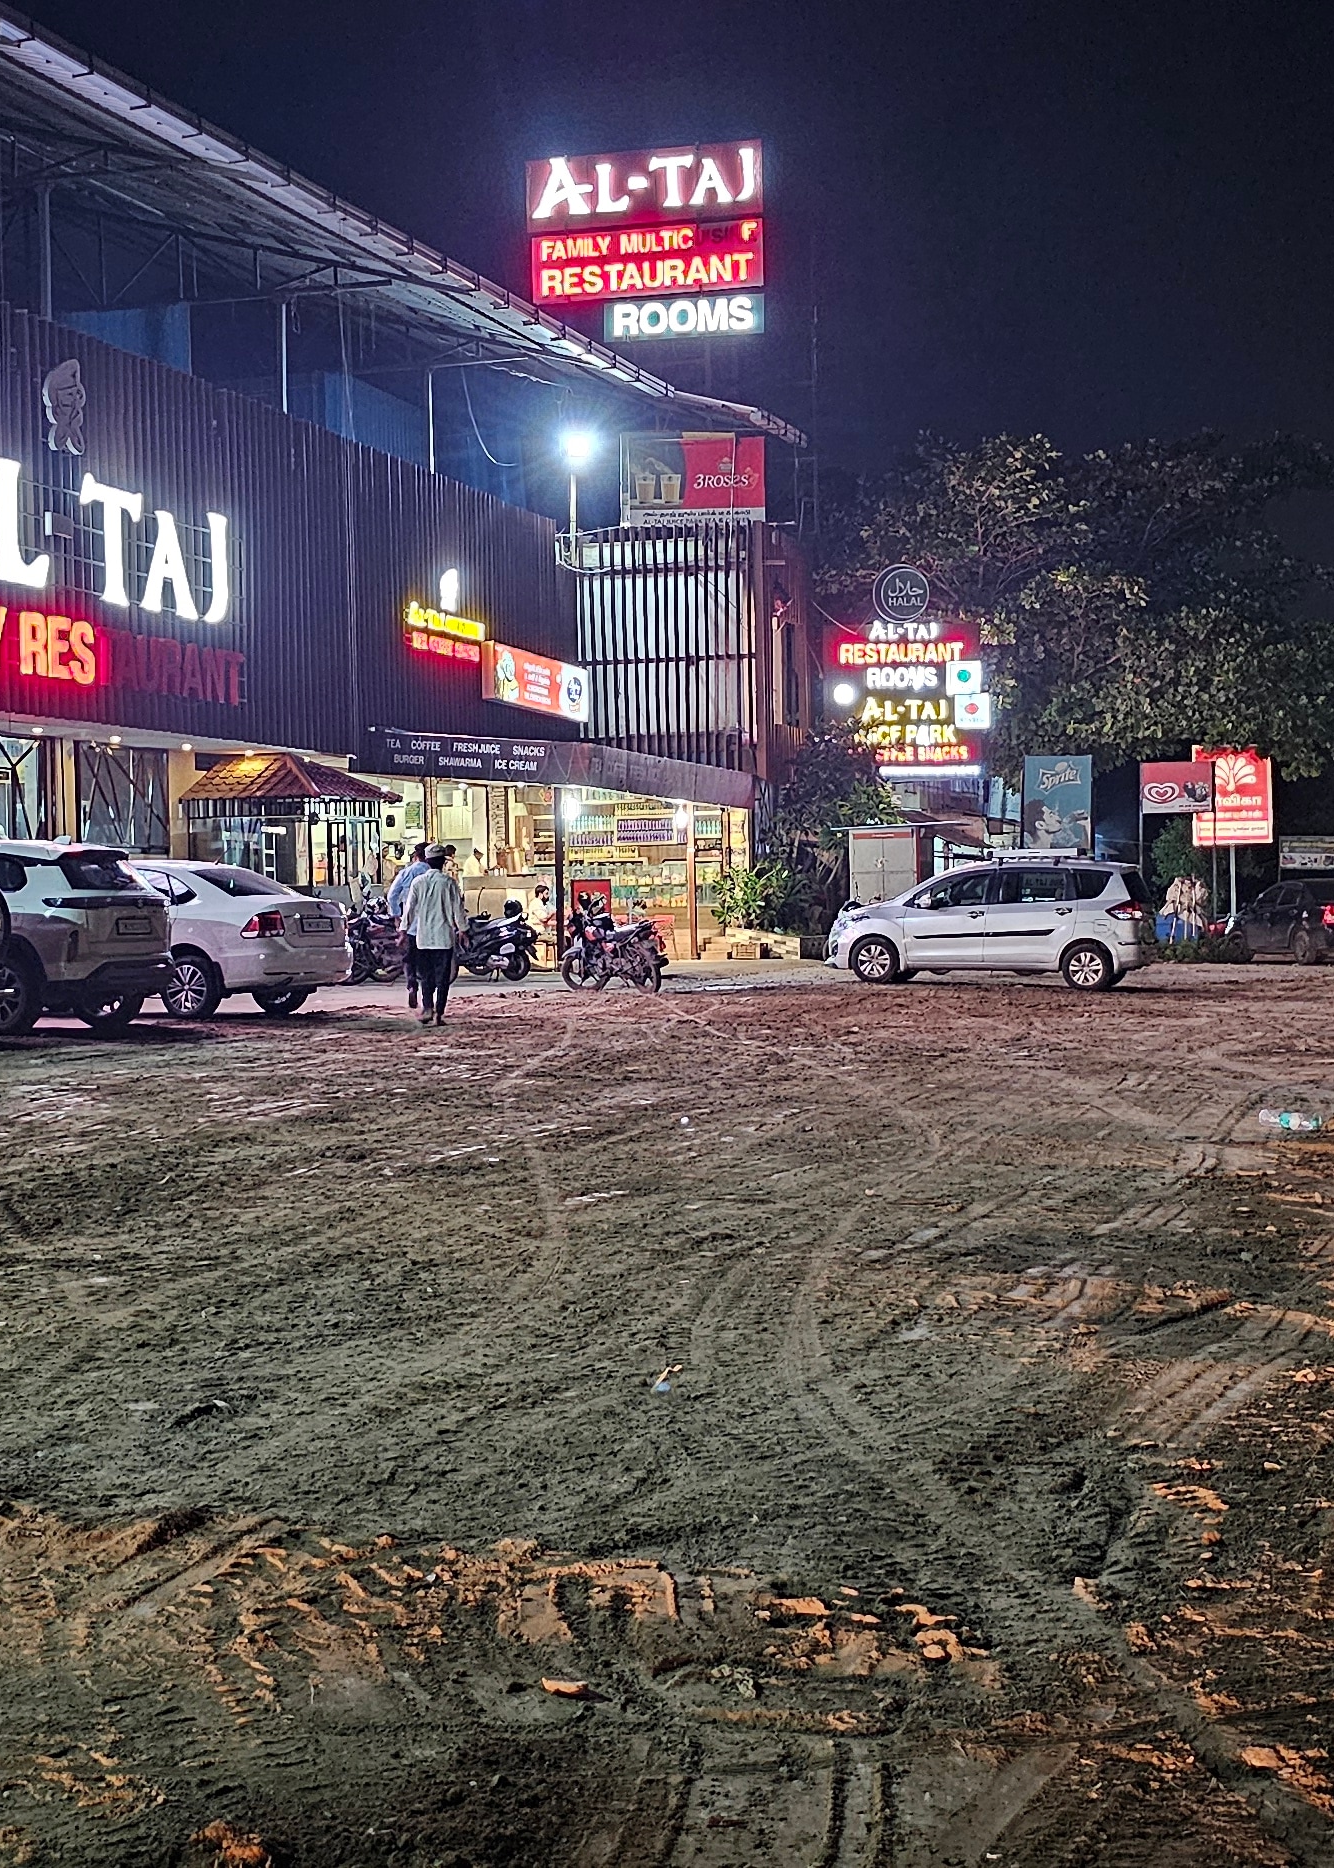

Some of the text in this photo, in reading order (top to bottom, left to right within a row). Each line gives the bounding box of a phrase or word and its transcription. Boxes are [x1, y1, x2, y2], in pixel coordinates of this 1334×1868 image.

[532, 148, 754, 218] AL-TAJ
[541, 235, 611, 262] FAMILY
[541, 252, 754, 297] RESTAURANT
[613, 297, 753, 337] ROOMS
[888, 578, 924, 597] حلال
[888, 596, 924, 607] HALAL
[839, 642, 965, 665] RESTAURANT
[866, 665, 938, 689] ROOMS
[905, 724, 958, 746] PARK
[386, 738, 545, 757] TEA COFFEE FRESH JUICE SNACKS
[917, 745, 969, 762] SNACKS
[393, 753, 537, 772] BURGER SHAWARMA ICE CREAM
[1040, 767, 1077, 790] Sprite
